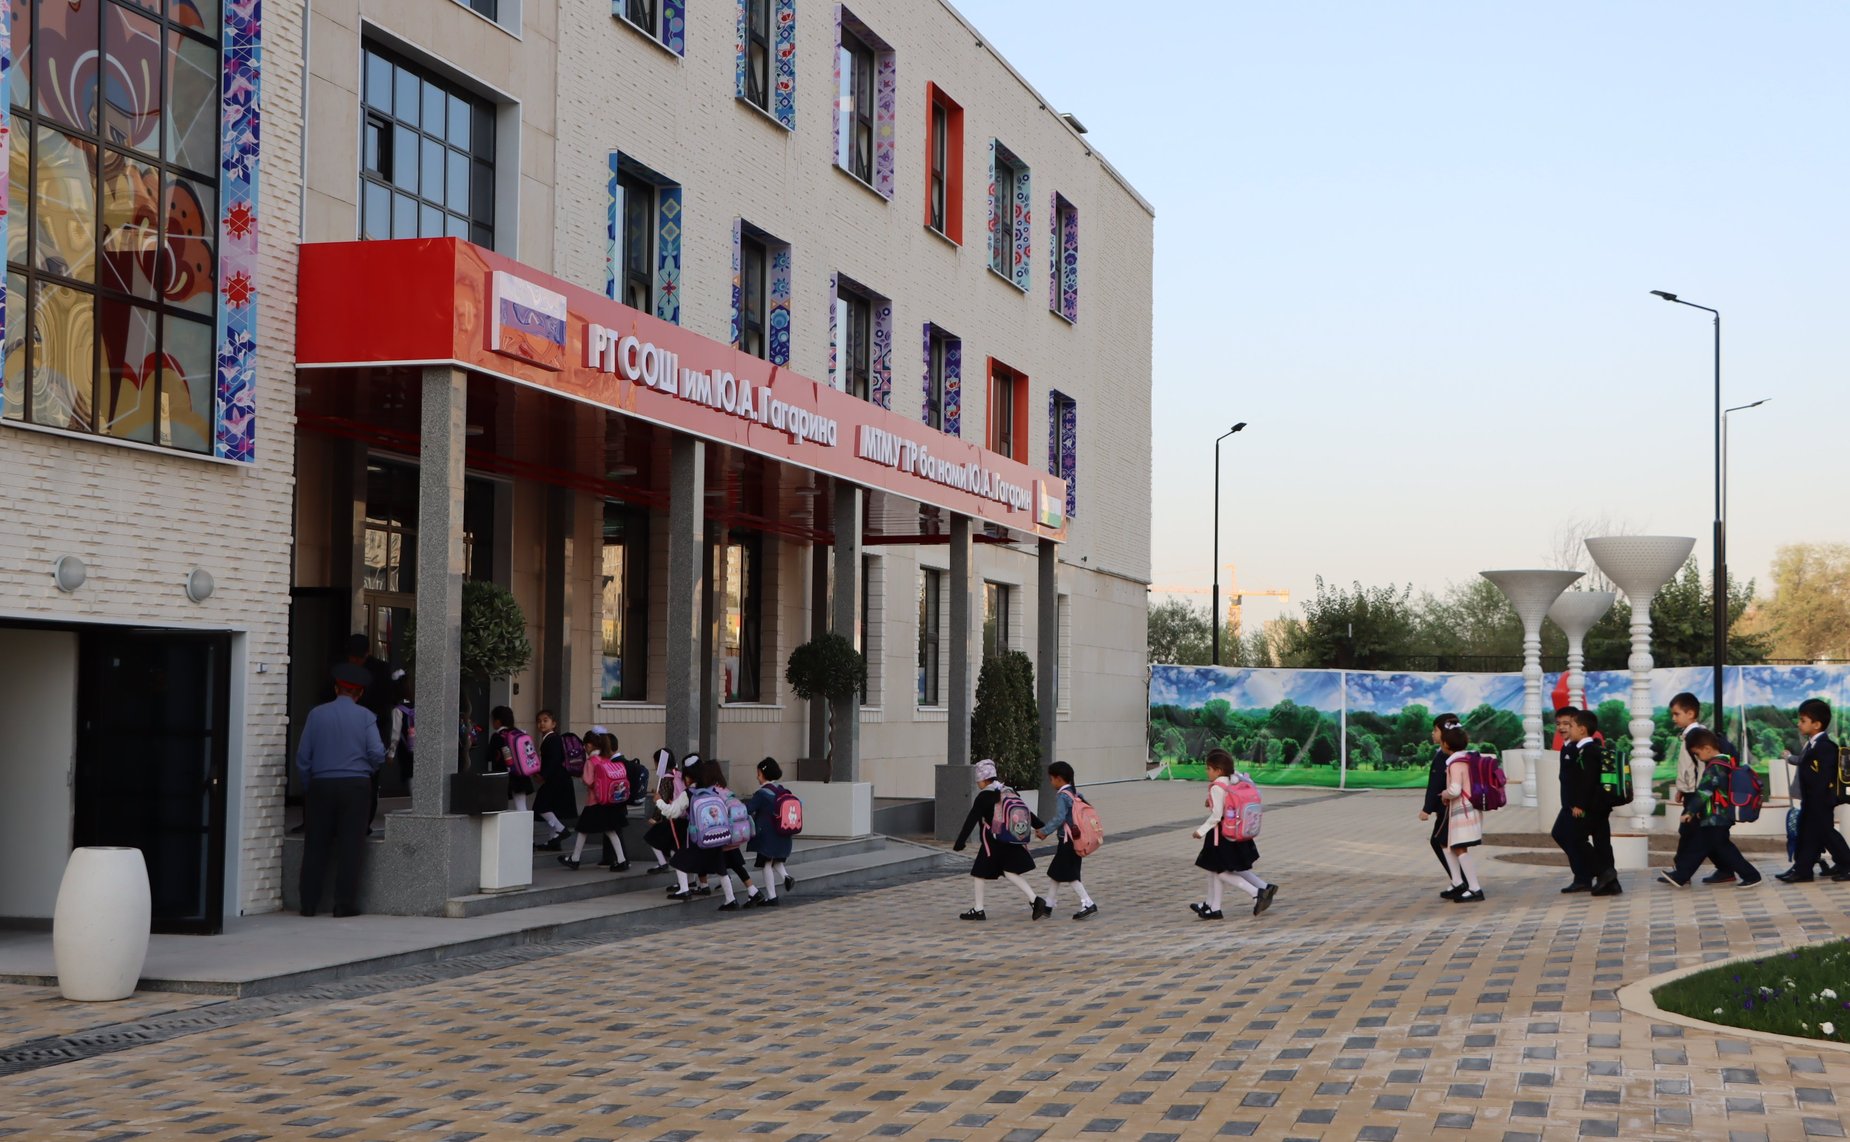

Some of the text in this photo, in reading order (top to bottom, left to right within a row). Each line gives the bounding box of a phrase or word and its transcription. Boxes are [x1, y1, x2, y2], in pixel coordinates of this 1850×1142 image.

[588, 323, 618, 374] РТ
[618, 335, 678, 395] СОШ
[860, 424, 901, 468] МТМУ
[901, 439, 917, 472] ТР
[915, 445, 935, 479] ба
[935, 459, 966, 490] номи
